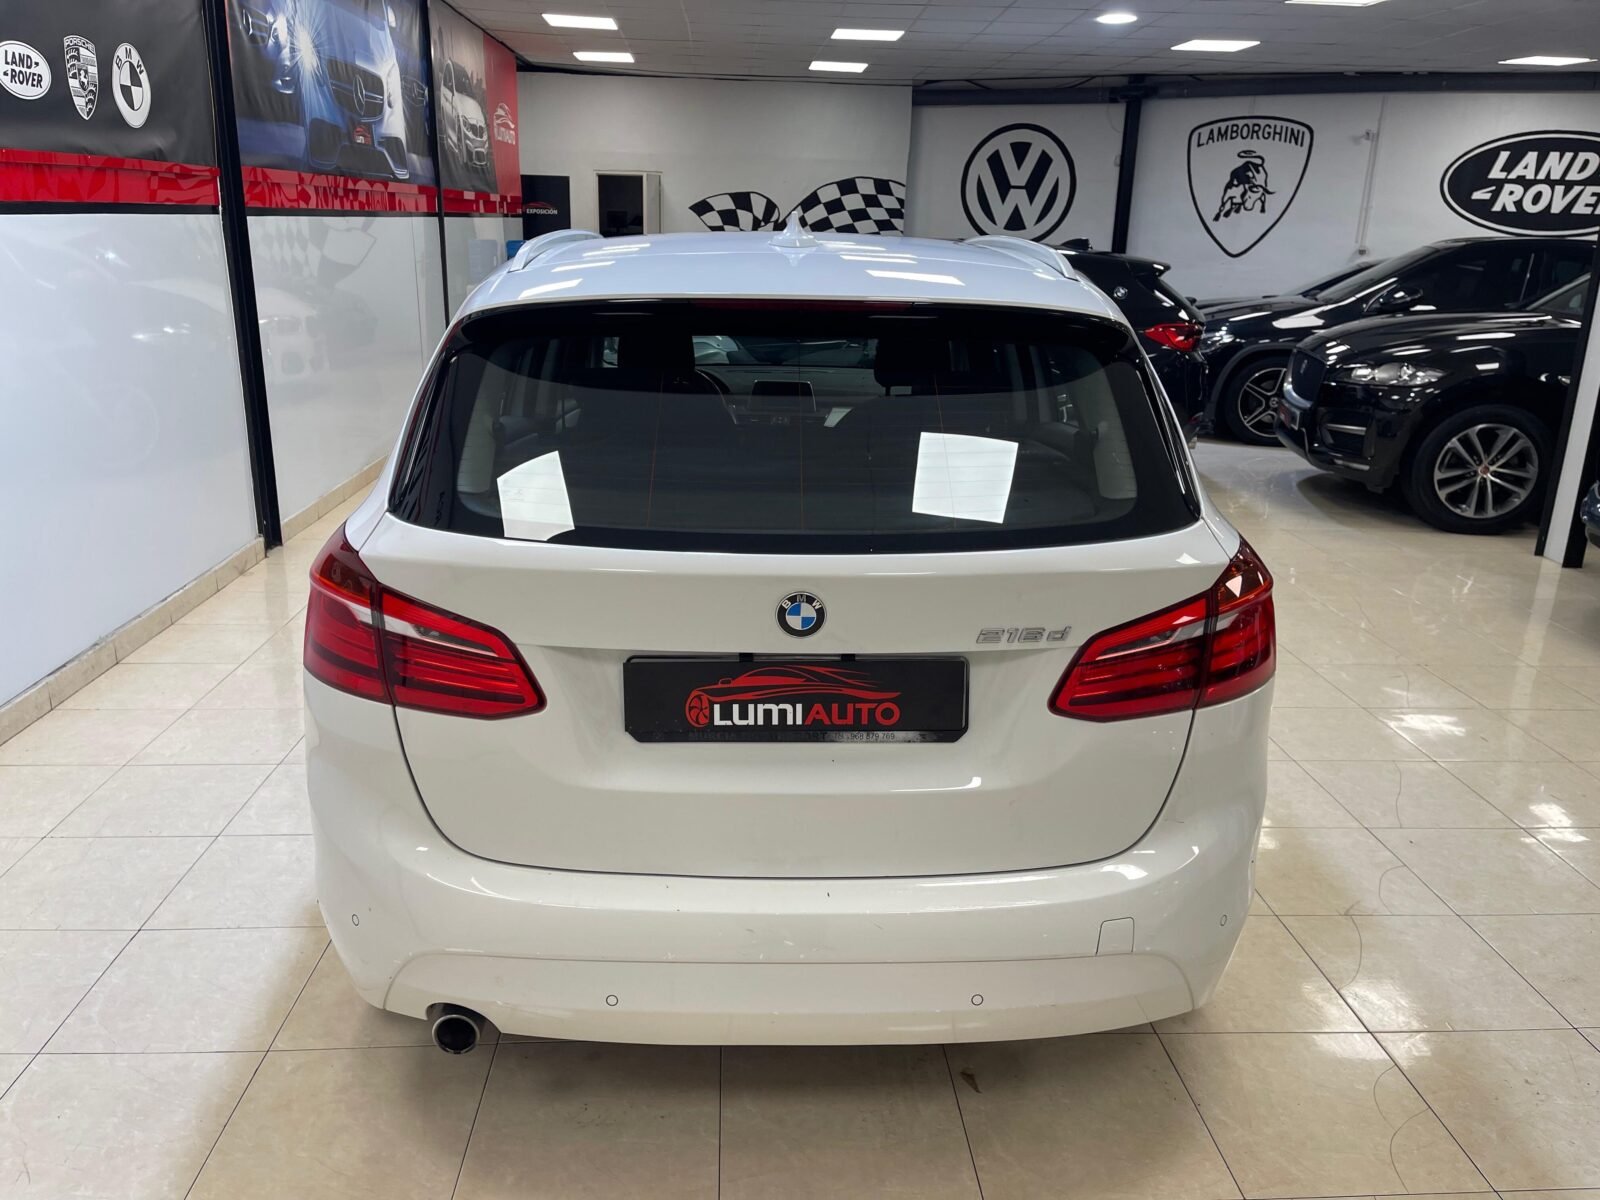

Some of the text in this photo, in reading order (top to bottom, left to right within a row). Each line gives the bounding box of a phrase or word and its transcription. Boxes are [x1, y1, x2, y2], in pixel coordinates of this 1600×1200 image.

[65, 37, 95, 53] PORSCHE
[4, 49, 33, 69] LAND
[115, 46, 145, 76] BMW
[10, 68, 43, 89] ROVER
[1197, 123, 1305, 147] LAMBORGHINI
[1487, 151, 1600, 181] LAND
[1490, 183, 1600, 214] ROVE
[781, 594, 822, 610] BMW
[713, 702, 900, 726] LUMIAUTO
